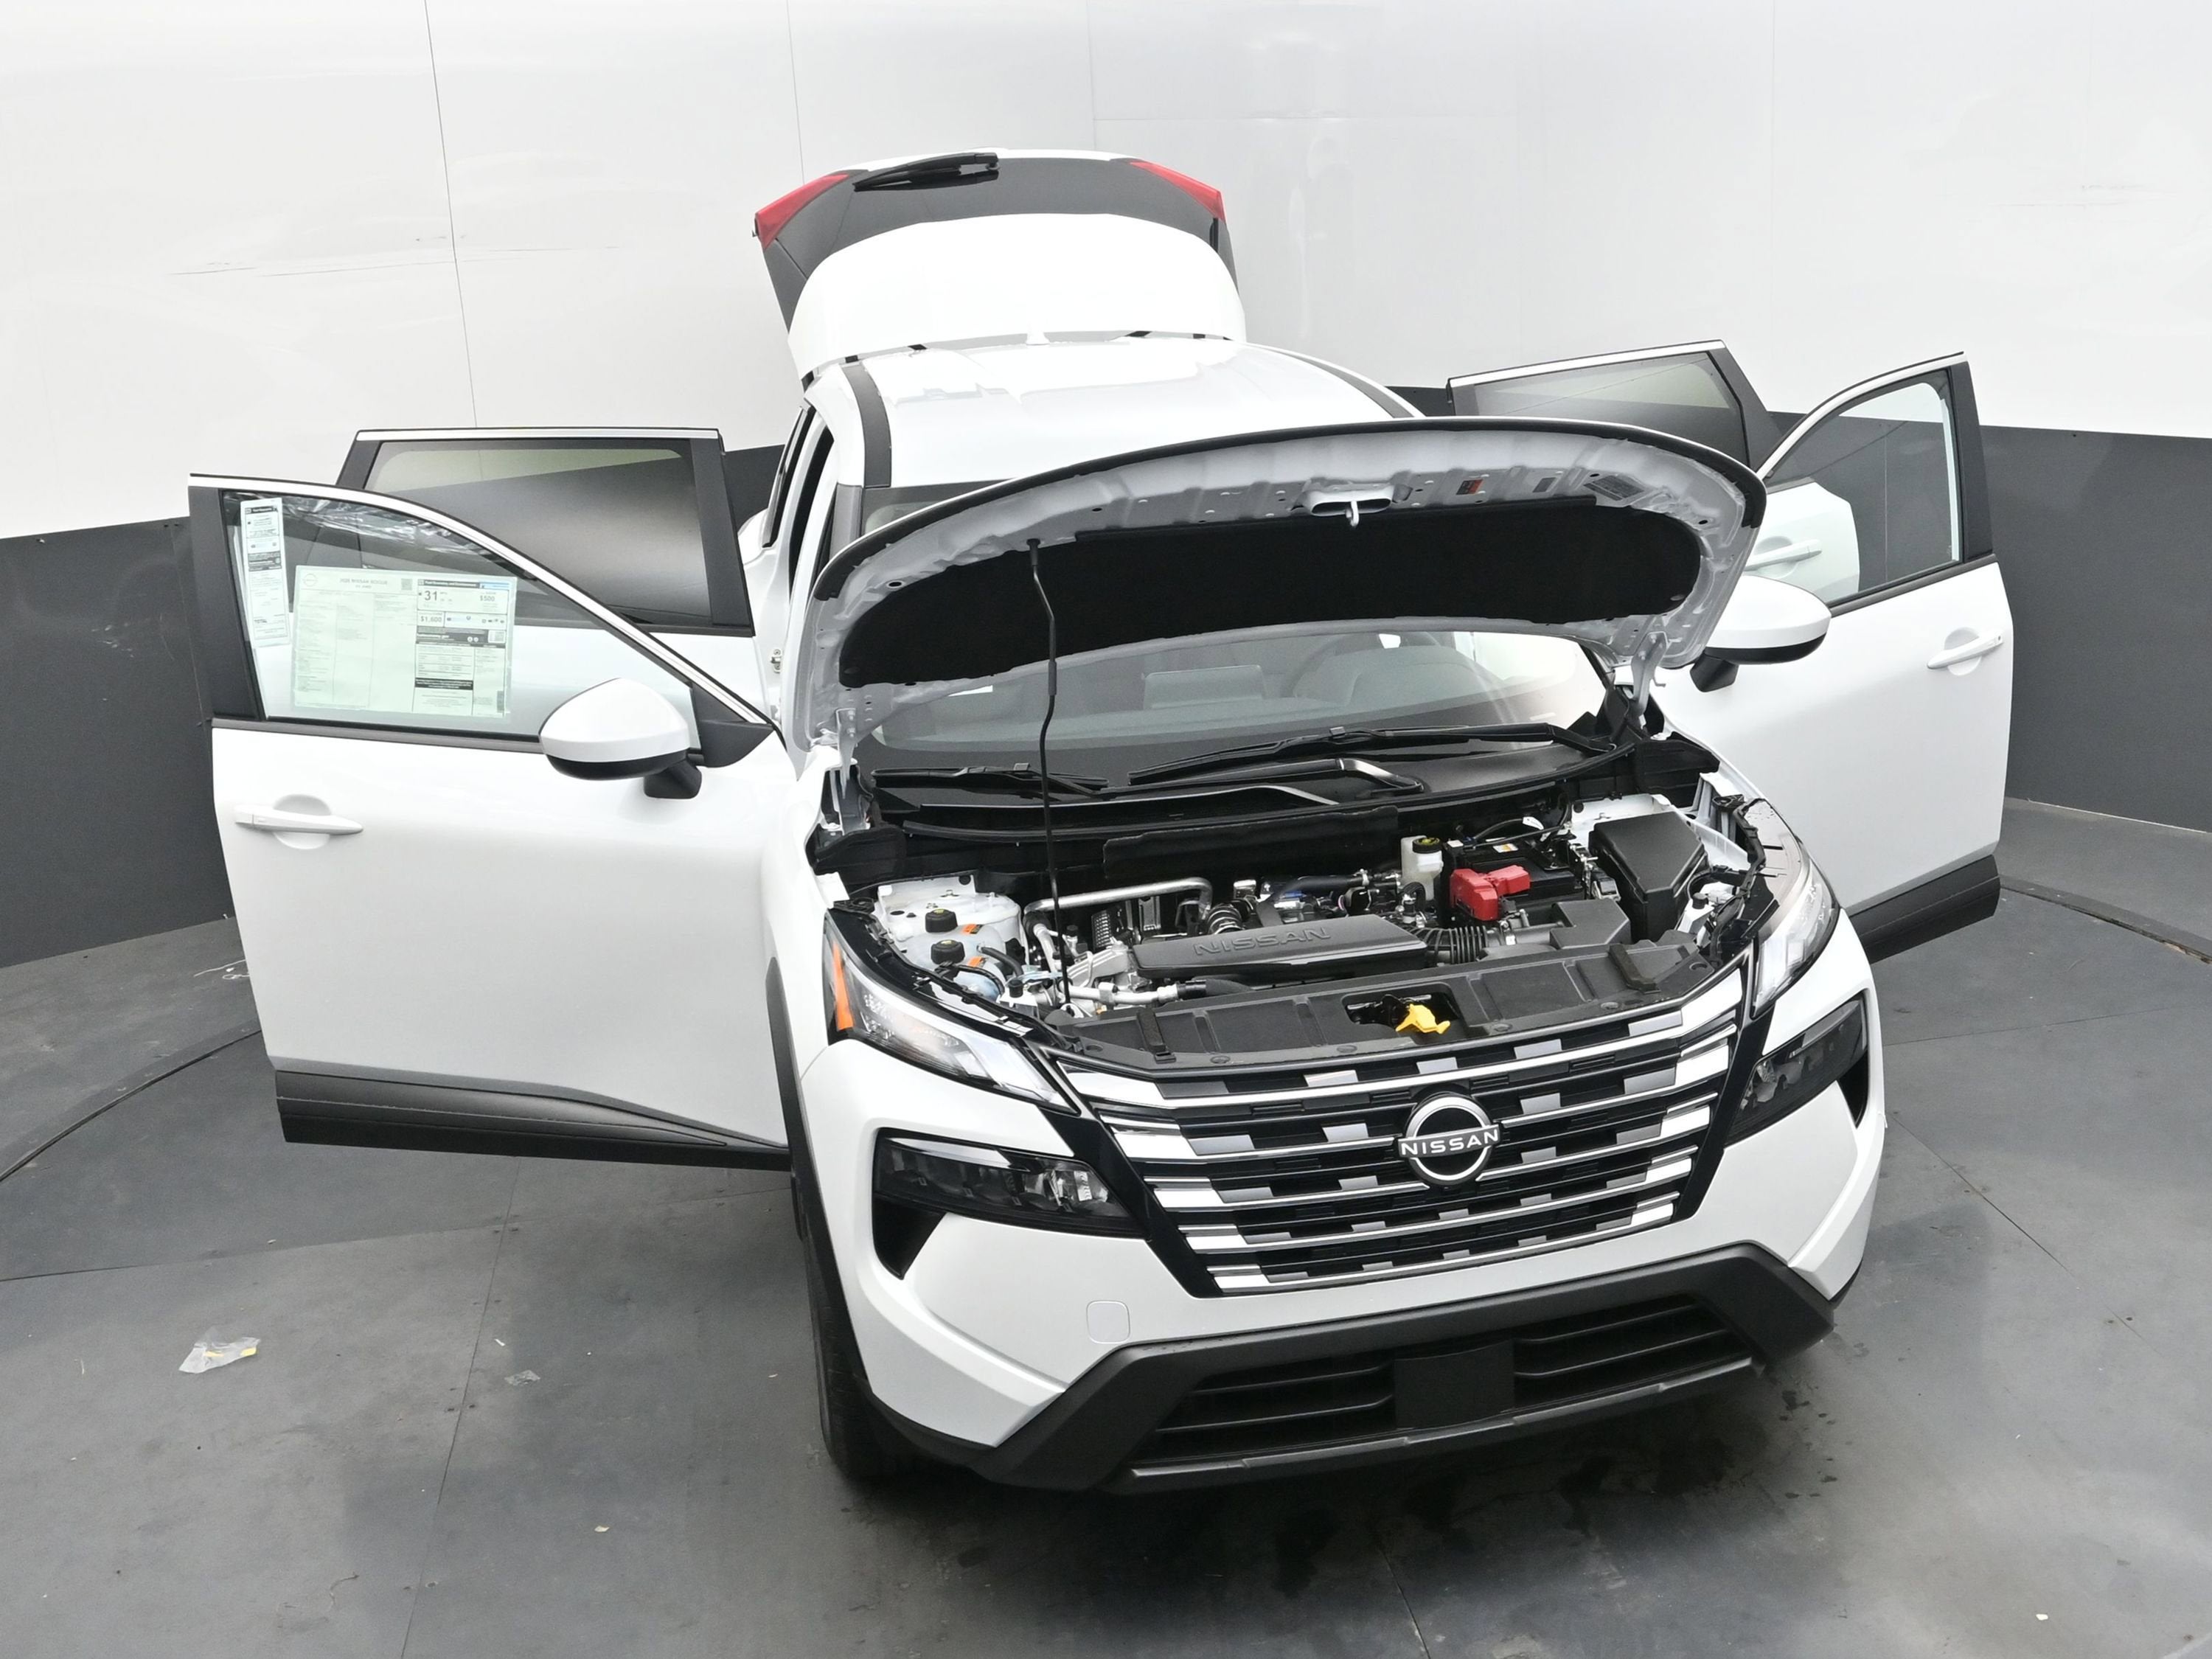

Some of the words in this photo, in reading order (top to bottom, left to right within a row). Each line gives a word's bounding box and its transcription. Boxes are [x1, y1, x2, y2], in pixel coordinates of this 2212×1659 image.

[424, 591, 438, 601] 31
[479, 594, 495, 602] $500
[1193, 926, 1331, 956] NISSAN
[1400, 1128, 1499, 1156] NISSAN
